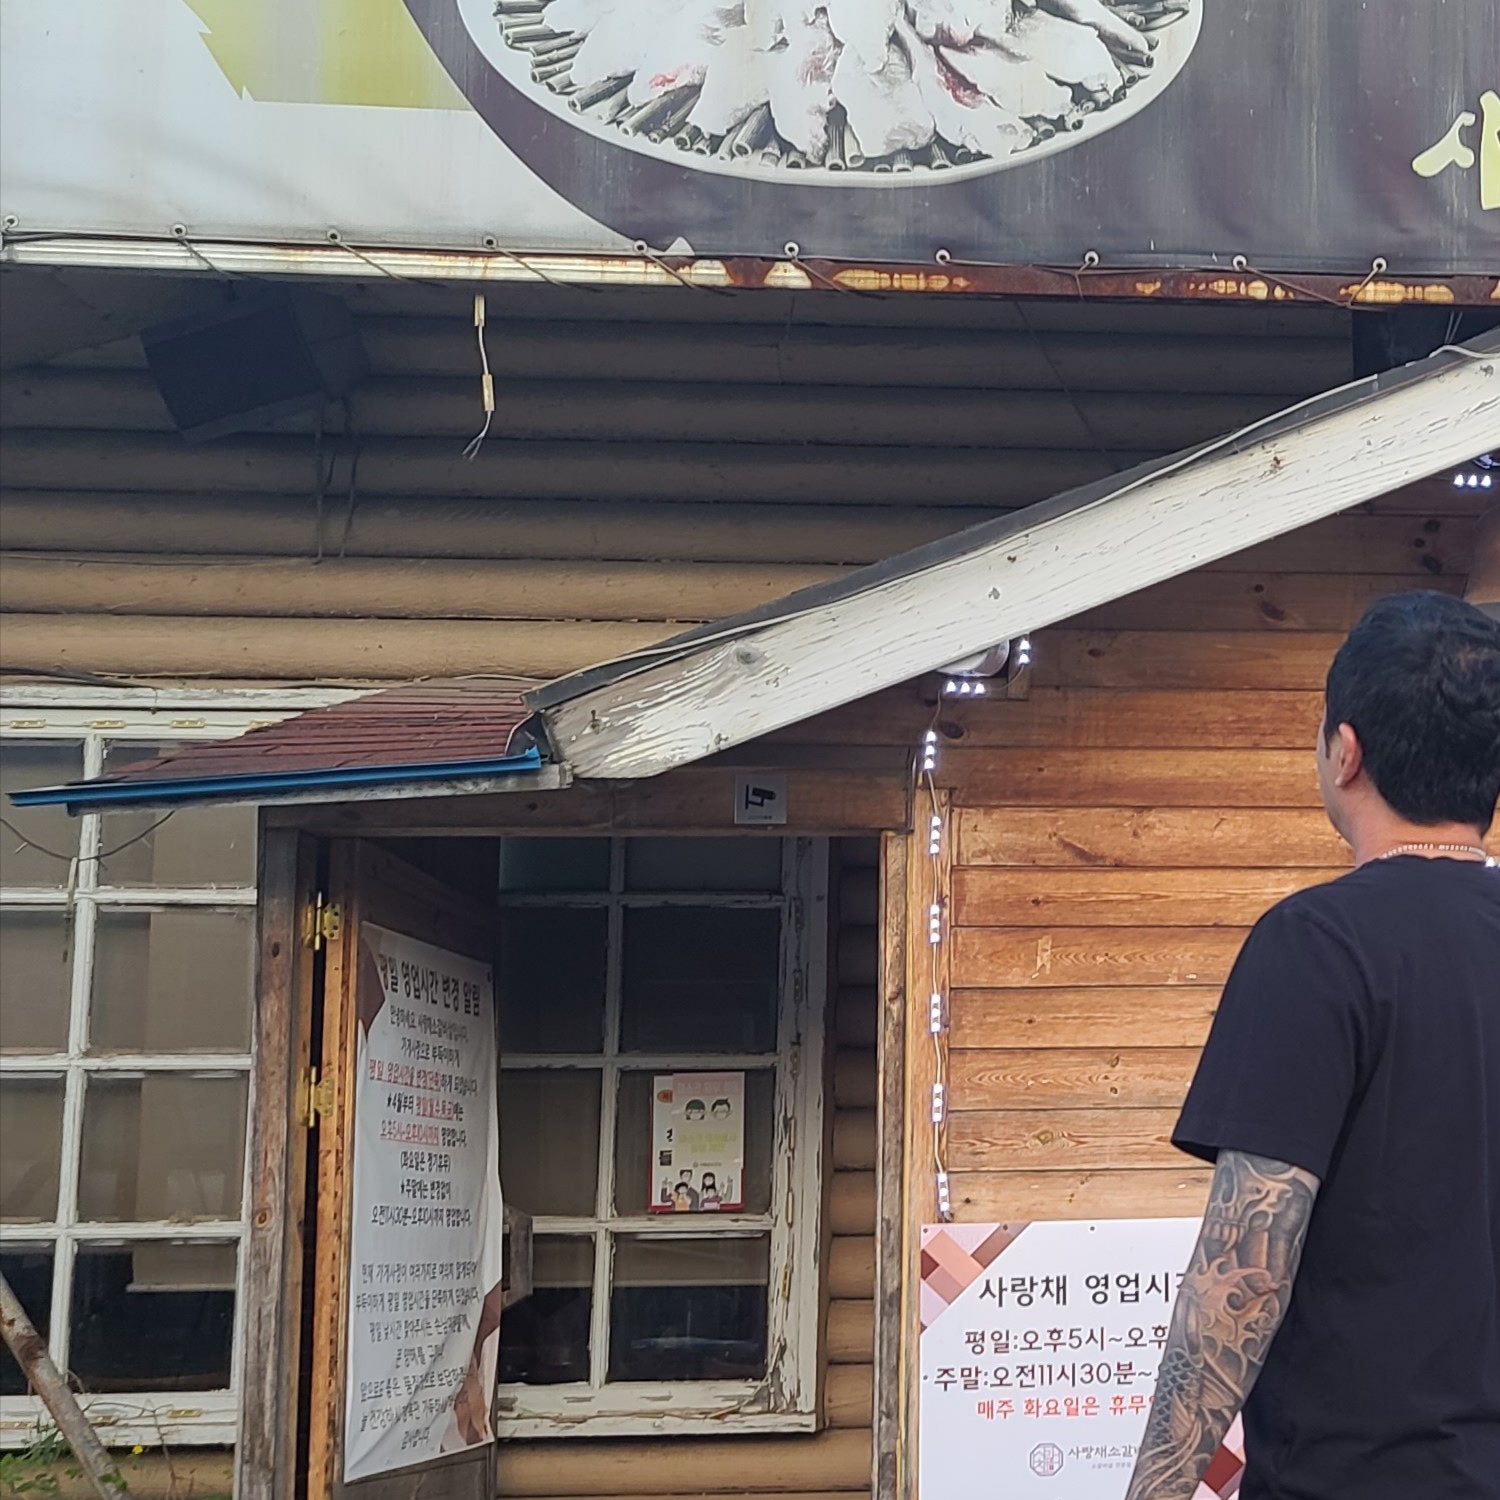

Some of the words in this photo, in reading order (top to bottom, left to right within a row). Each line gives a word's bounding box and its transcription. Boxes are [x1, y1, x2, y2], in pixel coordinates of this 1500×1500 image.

[378, 953, 398, 993] 평일
[401, 961, 438, 1005] 영업시간
[441, 974, 460, 1013] 변경
[463, 981, 481, 1017] 알림
[978, 1273, 1068, 1308] 사랑채
[933, 1360, 1161, 1392] 주말:오전11시30분~
[977, 1399, 1015, 1421] 매주
[1023, 1396, 1101, 1419] 화요일은
[1108, 1394, 1156, 1418] 휴무
